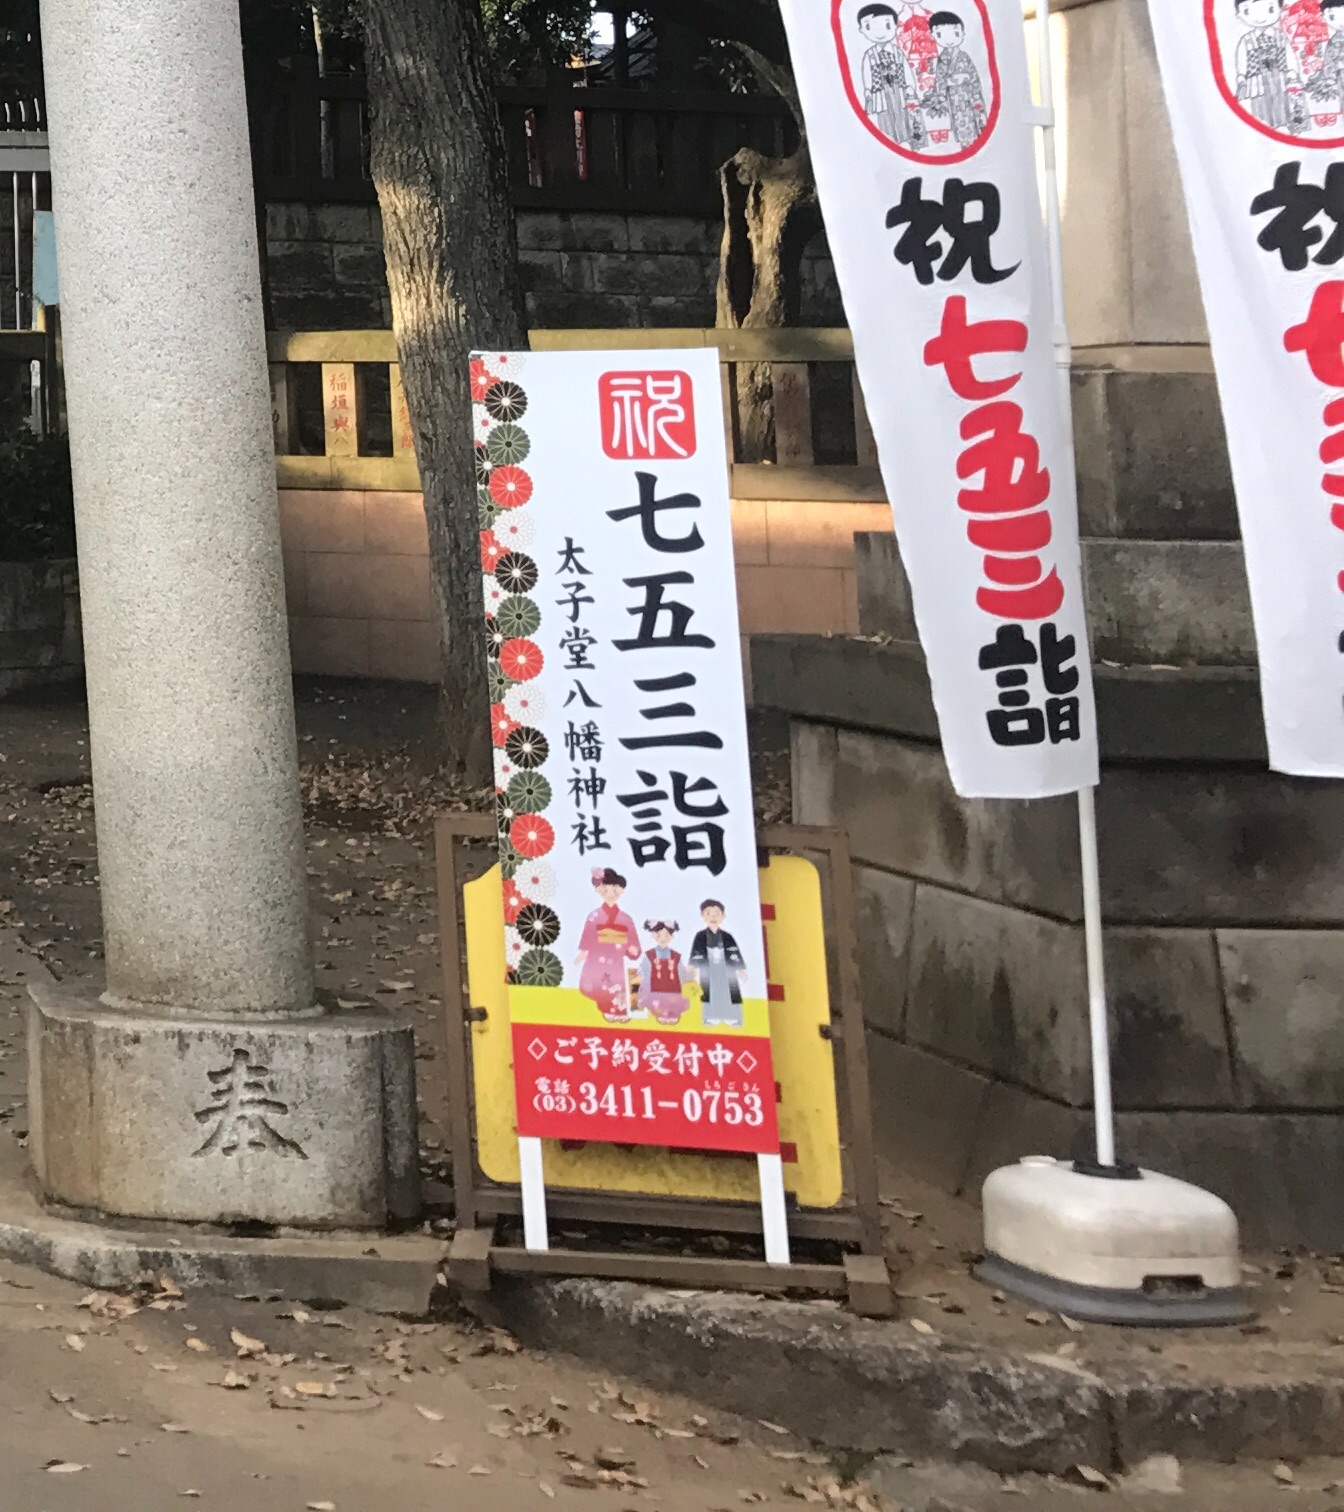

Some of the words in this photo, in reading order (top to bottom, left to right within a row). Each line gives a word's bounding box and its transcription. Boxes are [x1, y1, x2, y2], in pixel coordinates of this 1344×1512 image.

[609, 374, 688, 457] 祝
[885, 176, 1081, 746] 祝七五三詣
[554, 536, 612, 857] 太子堂八幡神社
[606, 471, 730, 877] 七五三詣
[191, 1048, 309, 1160] 奉
[532, 1094, 577, 1113] (03)
[578, 1081, 764, 1126] 3411-0753
[553, 1036, 734, 1078] ご予約受付中
